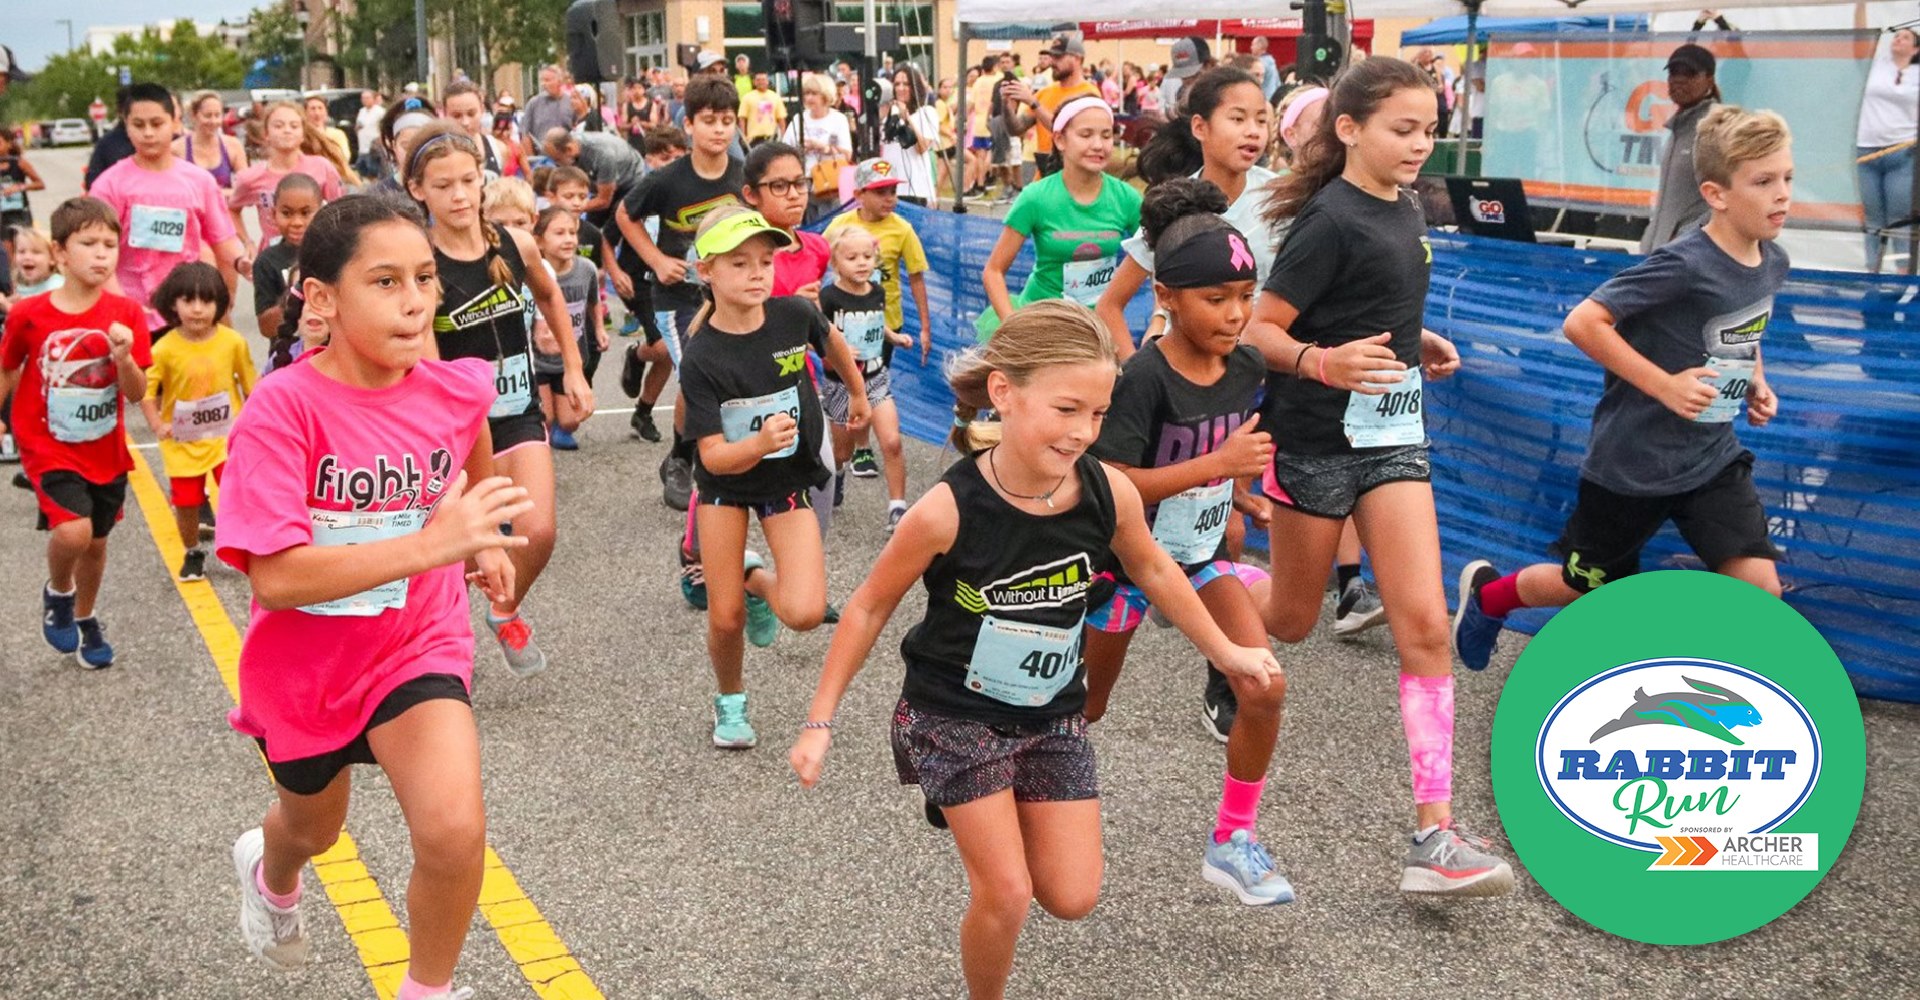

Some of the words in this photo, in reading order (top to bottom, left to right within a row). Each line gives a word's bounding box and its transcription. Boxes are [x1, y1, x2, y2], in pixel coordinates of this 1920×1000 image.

[1625, 80, 1677, 133] G
[1479, 201, 1503, 213] GO
[150, 220, 184, 236] 4029
[457, 309, 490, 325] Without
[492, 299, 516, 314] Limits
[494, 370, 529, 395] 014
[1720, 378, 1747, 400] 40
[192, 405, 229, 425] 3087
[1375, 389, 1421, 417] 4018
[317, 458, 421, 510] fight
[1194, 499, 1232, 535] 4001
[993, 589, 1046, 604] Without
[1049, 582, 1087, 600] Limits
